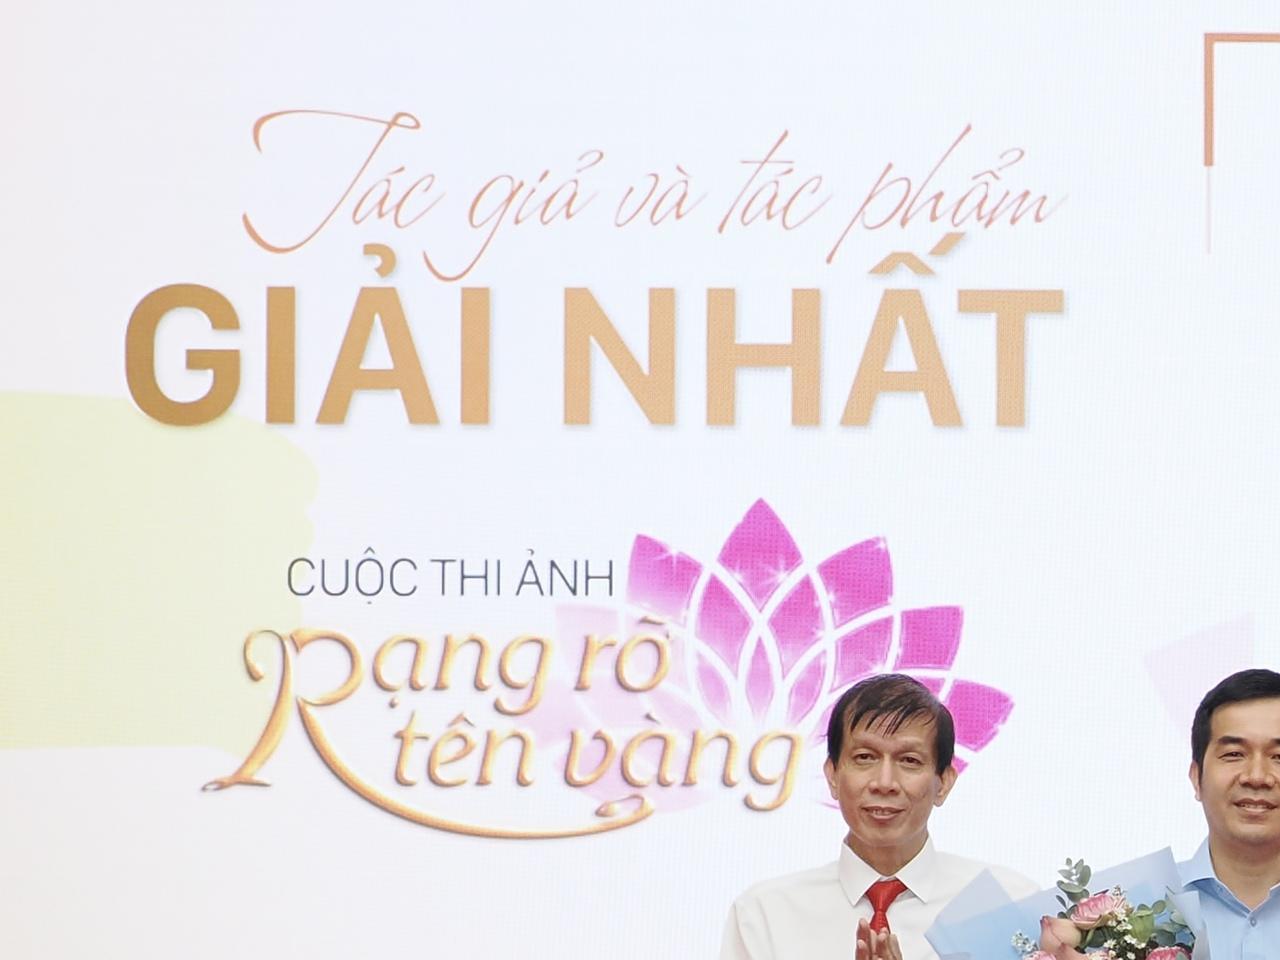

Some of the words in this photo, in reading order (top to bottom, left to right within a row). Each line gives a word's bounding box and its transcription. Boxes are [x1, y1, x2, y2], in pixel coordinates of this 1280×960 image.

[242, 109, 446, 254] Tác
[422, 149, 605, 282] giả
[614, 164, 702, 228] và
[717, 129, 830, 234] tác
[825, 123, 1067, 264] phẩm
[124, 242, 491, 428] GIẢI
[562, 232, 1065, 428] NHẤT
[287, 546, 418, 605] CUỘC
[430, 558, 501, 597] THI
[515, 547, 614, 597] ẢNH
[393, 710, 536, 788] tên
[564, 712, 803, 812] vàng
